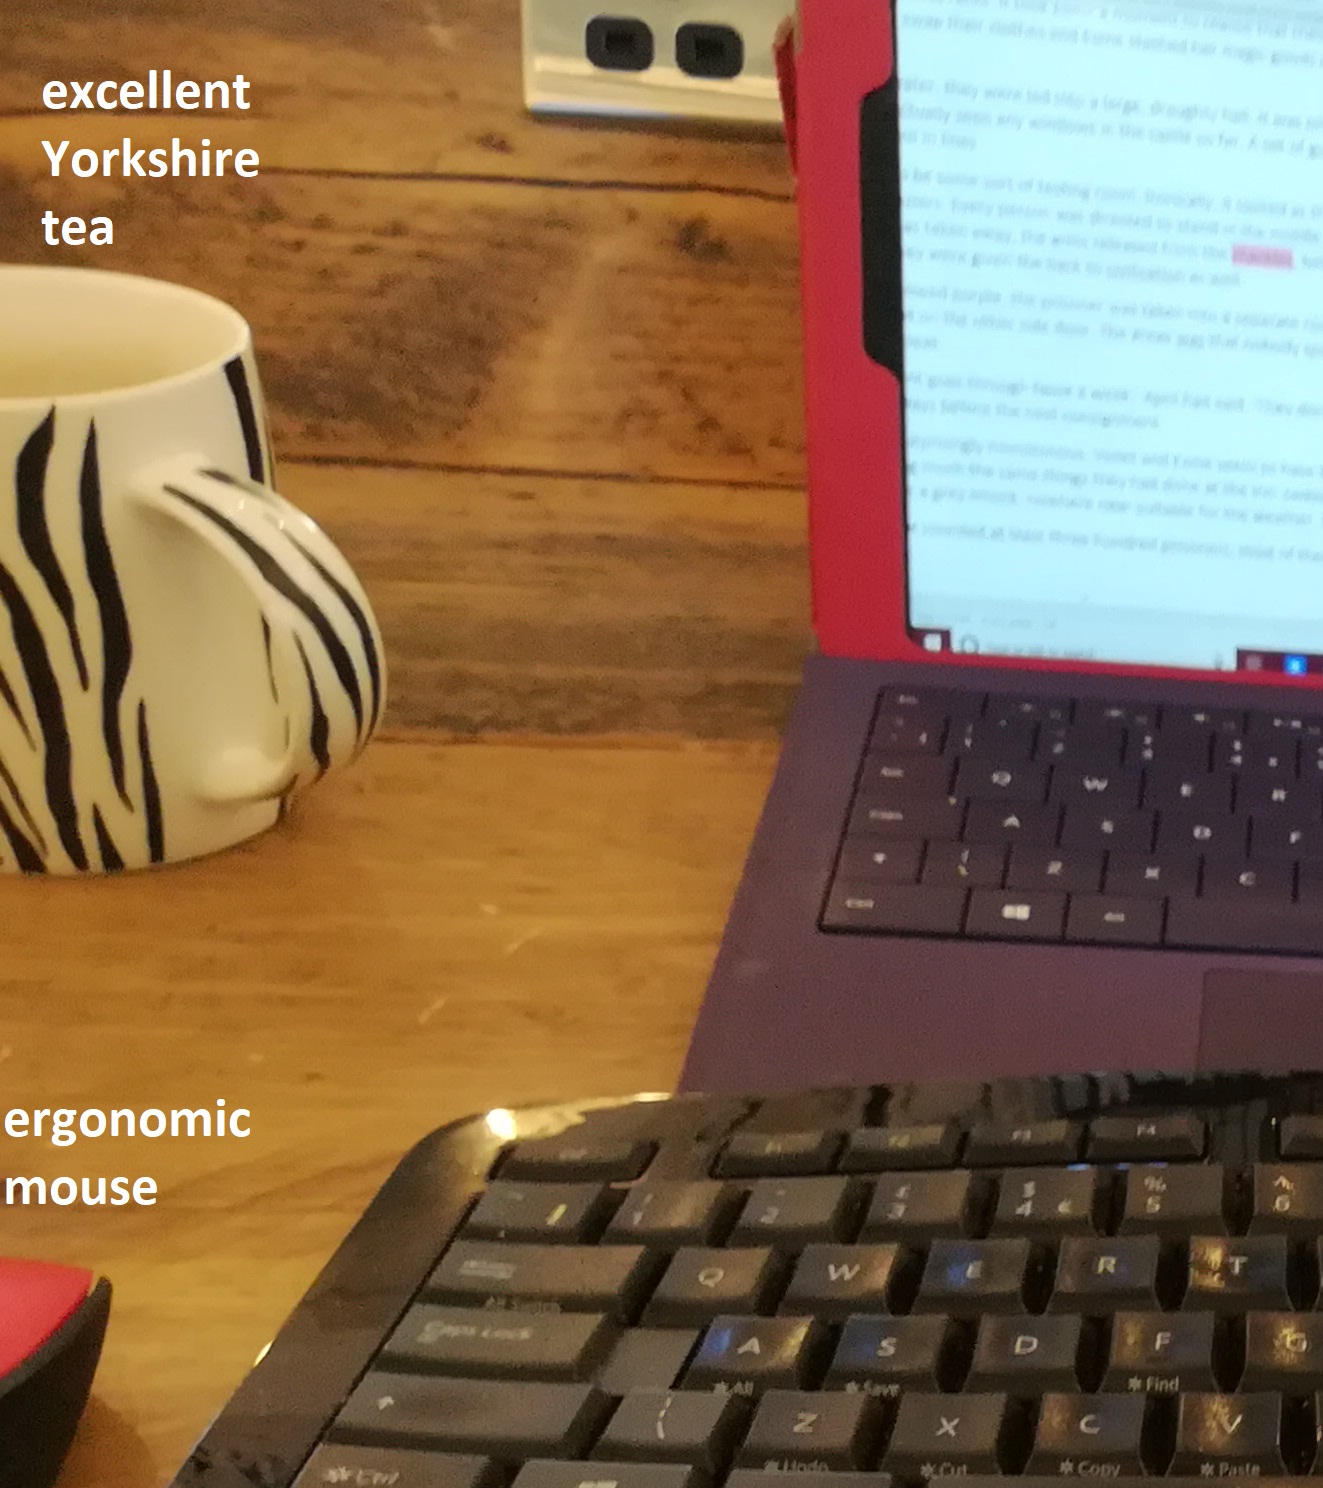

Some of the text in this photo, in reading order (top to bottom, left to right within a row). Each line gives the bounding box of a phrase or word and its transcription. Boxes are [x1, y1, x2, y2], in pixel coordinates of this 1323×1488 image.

[828, 1263, 861, 1282] W
[1097, 1255, 1118, 1275] R
[1228, 1255, 1249, 1276] T
[698, 1266, 725, 1288] Q
[738, 1336, 761, 1356] A
[877, 1336, 897, 1357] S
[1014, 1334, 1039, 1356] D
[1154, 1331, 1172, 1351] F
[1146, 1374, 1180, 1391] Find
[793, 1412, 818, 1434] Z
[935, 1416, 960, 1437] X
[1079, 1413, 1102, 1435] C
[1221, 1413, 1244, 1434] V
[1077, 1460, 1121, 1479] Copy
[1218, 1461, 1261, 1478] Paste
